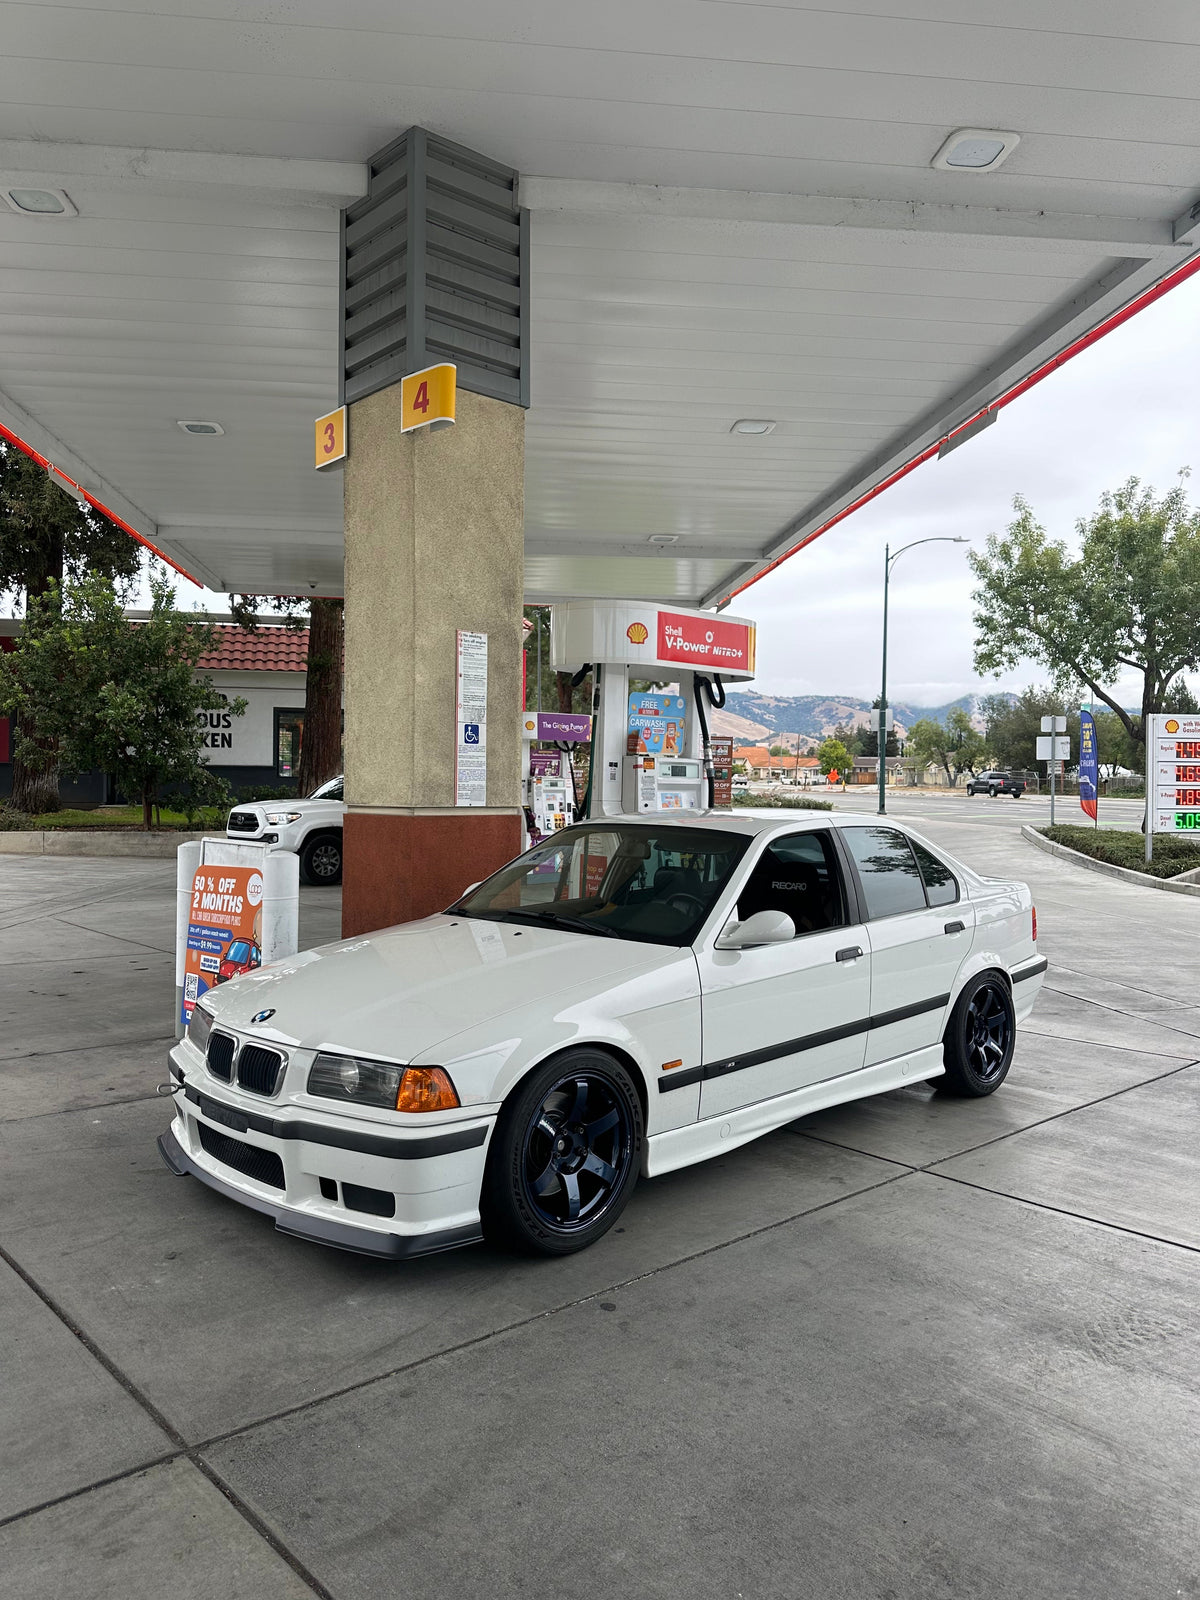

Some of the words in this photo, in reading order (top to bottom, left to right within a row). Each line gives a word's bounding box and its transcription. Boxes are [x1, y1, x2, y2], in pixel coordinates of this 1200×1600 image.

[413, 380, 429, 413] 4
[323, 422, 335, 454] 3
[665, 625, 683, 636] Shell
[665, 635, 710, 654] V-Power
[641, 700, 658, 709] FREE
[196, 712, 232, 729] OUS
[570, 722, 583, 731] Pump
[200, 732, 232, 748] KEN
[194, 875, 205, 891] 50
[207, 877, 214, 891] %
[218, 877, 237, 894] OFF
[771, 881, 807, 890] RECARO
[193, 891, 200, 908] 2
[201, 892, 244, 914] MONTHS
